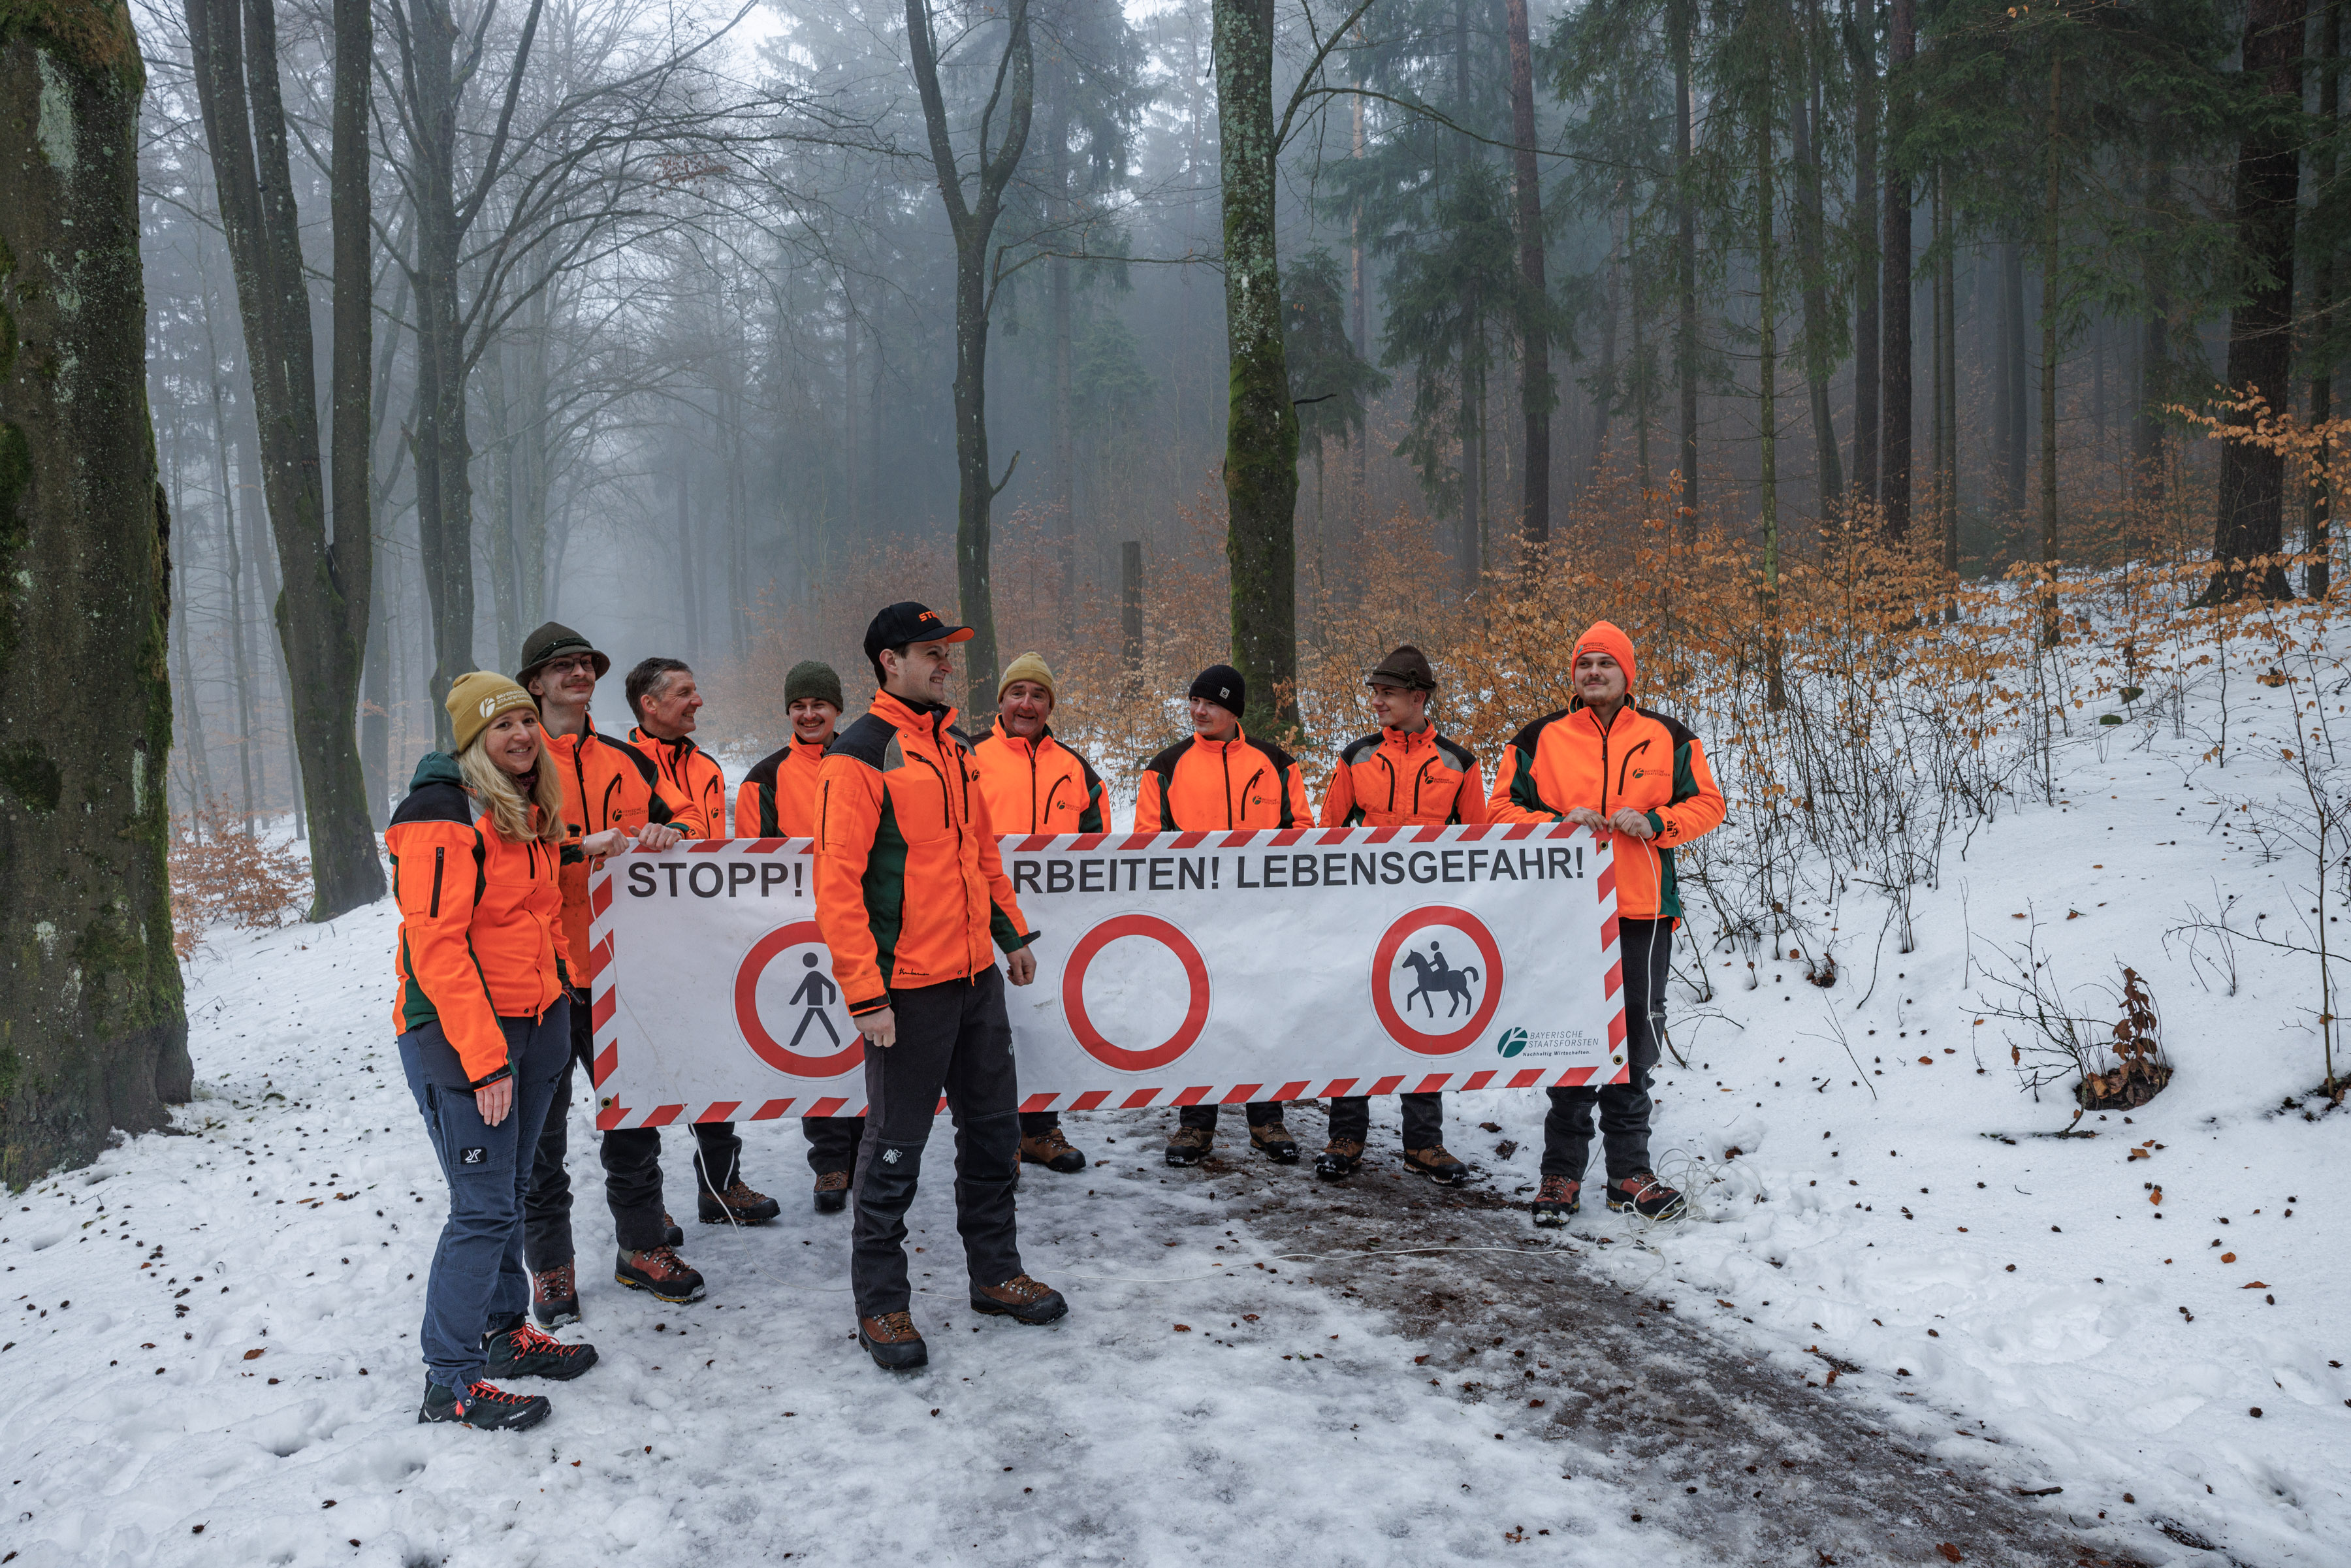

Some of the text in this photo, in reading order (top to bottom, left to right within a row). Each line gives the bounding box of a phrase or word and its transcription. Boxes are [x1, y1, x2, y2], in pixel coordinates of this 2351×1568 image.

[628, 861, 803, 897] STOPP!
[1238, 847, 1583, 888] LEBENSGEFAHR!
[1530, 1031, 1583, 1039] BAYERISCHE
[1529, 1038, 1599, 1048] STAATSFORSTEN
